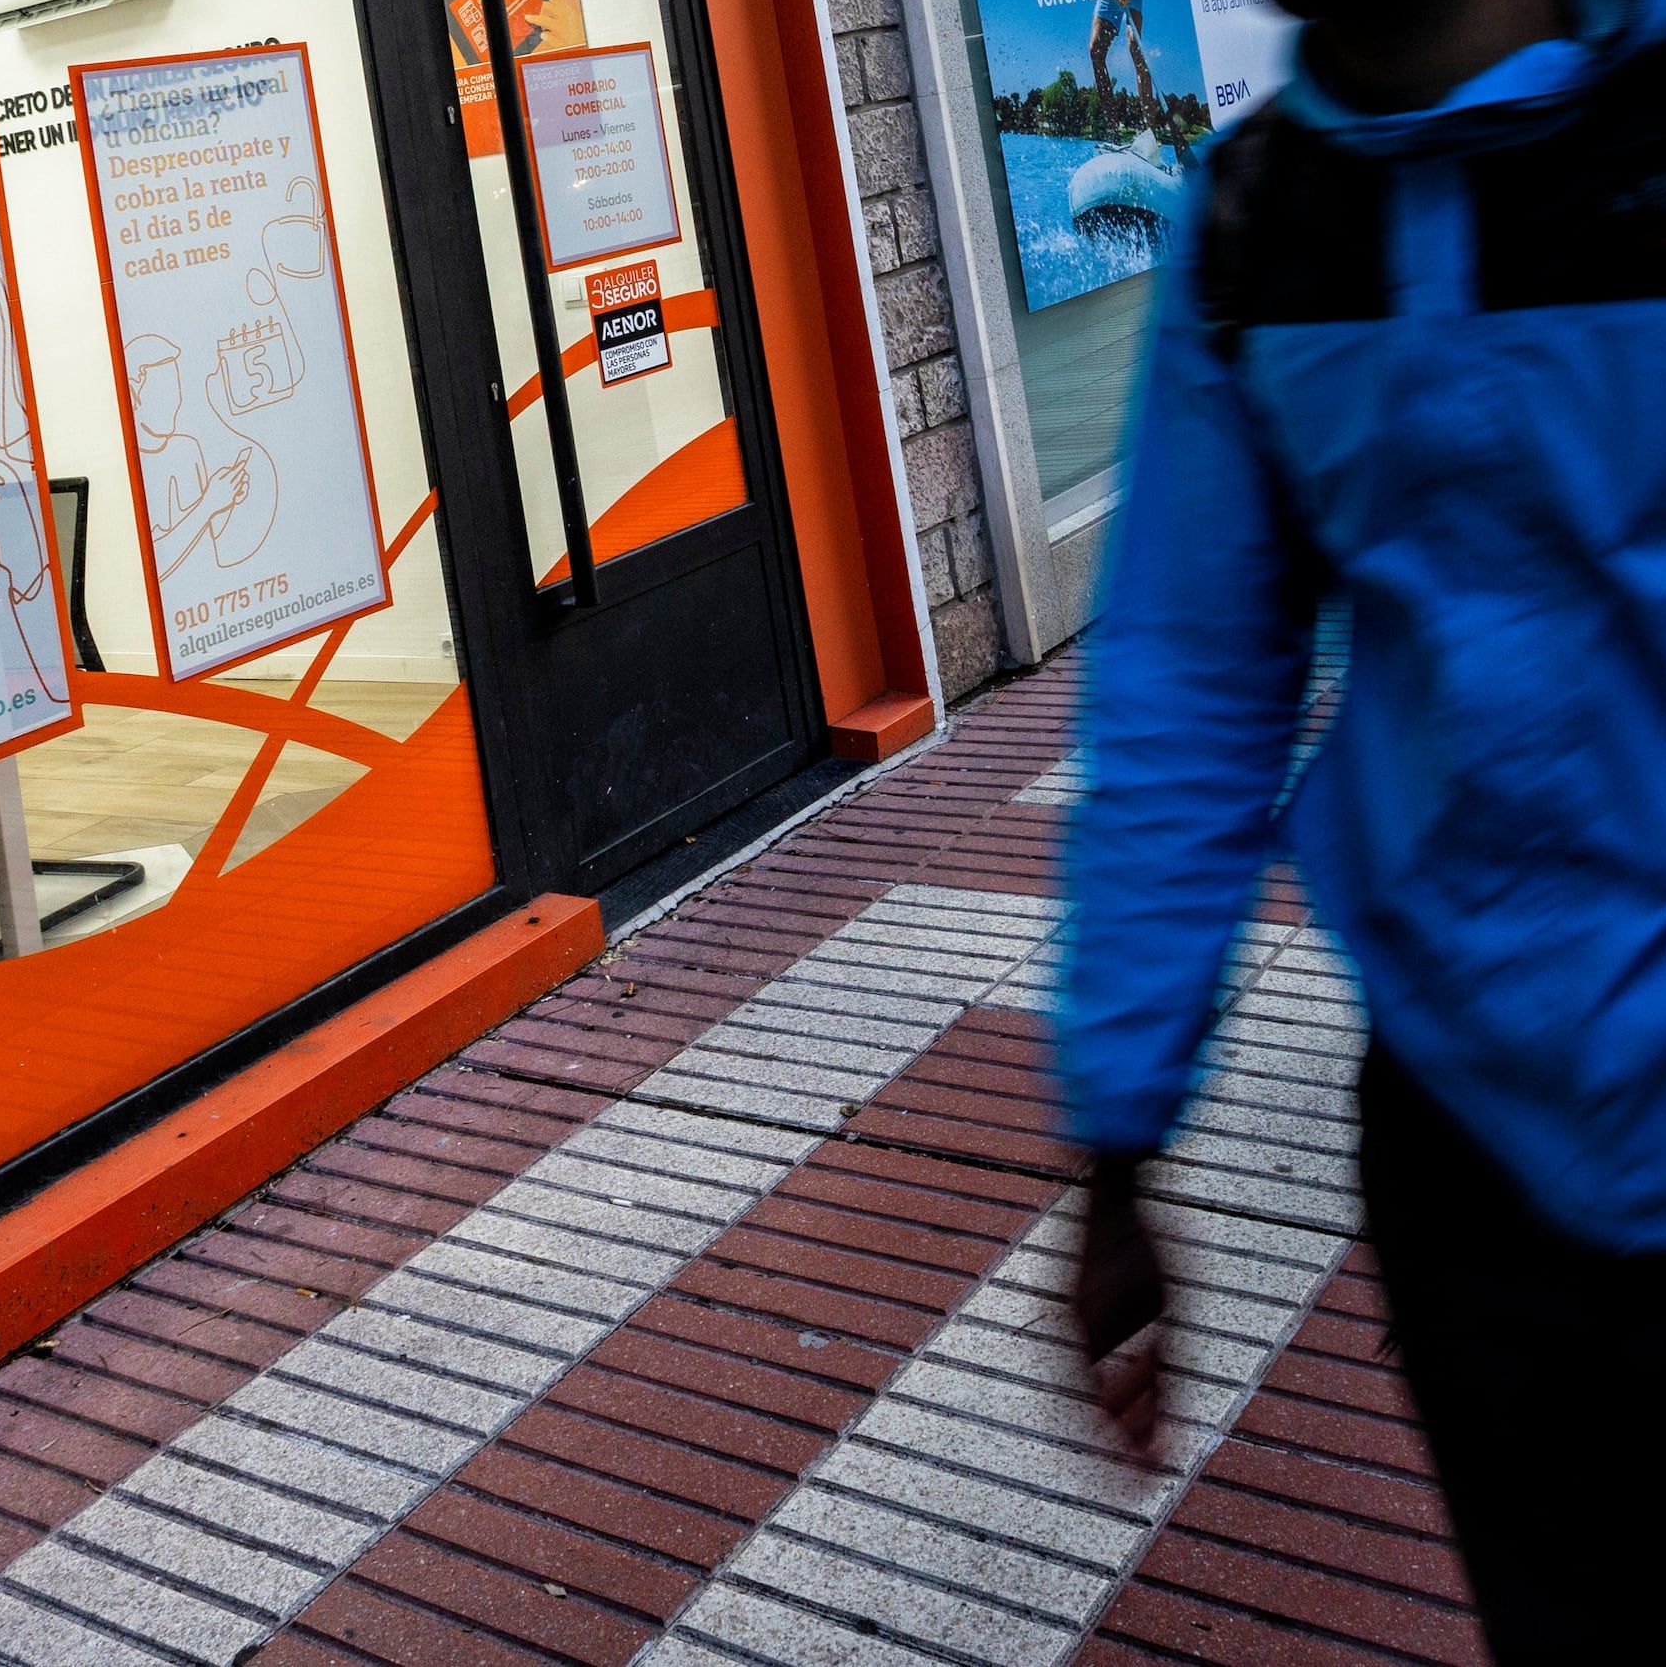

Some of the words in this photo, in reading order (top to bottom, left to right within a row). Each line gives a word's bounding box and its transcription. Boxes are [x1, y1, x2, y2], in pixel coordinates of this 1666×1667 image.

[101, 84, 194, 122] ¿Tienes
[198, 85, 233, 103] un
[236, 70, 289, 99] local
[459, 93, 494, 104] EMPEZAR
[568, 78, 617, 97] HORARIO
[1215, 78, 1251, 108] BBVA
[564, 96, 626, 117] COMERCIAL
[38, 121, 64, 149] UN
[104, 130, 122, 148] u
[128, 111, 221, 146] oficina?
[562, 128, 591, 143] Lunes
[600, 121, 636, 136] Viernes
[108, 137, 275, 179] Despreocúpate
[278, 134, 292, 158] y
[571, 139, 632, 161] 10:00-14:00
[574, 158, 635, 181] 17:00-20:00
[114, 180, 179, 213] cobra
[183, 177, 206, 201] la
[210, 168, 268, 195] renta
[587, 191, 633, 210] Sábados
[119, 219, 140, 245] el
[147, 213, 184, 241] día
[188, 208, 202, 232] 5
[204, 205, 233, 229] de
[583, 208, 643, 232] 10:00-14:00
[123, 244, 180, 279] cada
[183, 241, 232, 269] mes
[603, 266, 655, 290] ALQUILER
[605, 279, 657, 306] SEGURO
[602, 309, 658, 341] AENOR
[604, 341, 645, 360] COMPROMISO
[645, 337, 658, 348] CON
[606, 358, 619, 369] LAS
[618, 349, 651, 366] PERSONAS
[607, 362, 637, 378] MAYORES
[174, 602, 210, 632] 910
[214, 586, 250, 618] 775
[253, 572, 290, 605] 775
[179, 573, 375, 658] alquilersegurolocales.es
